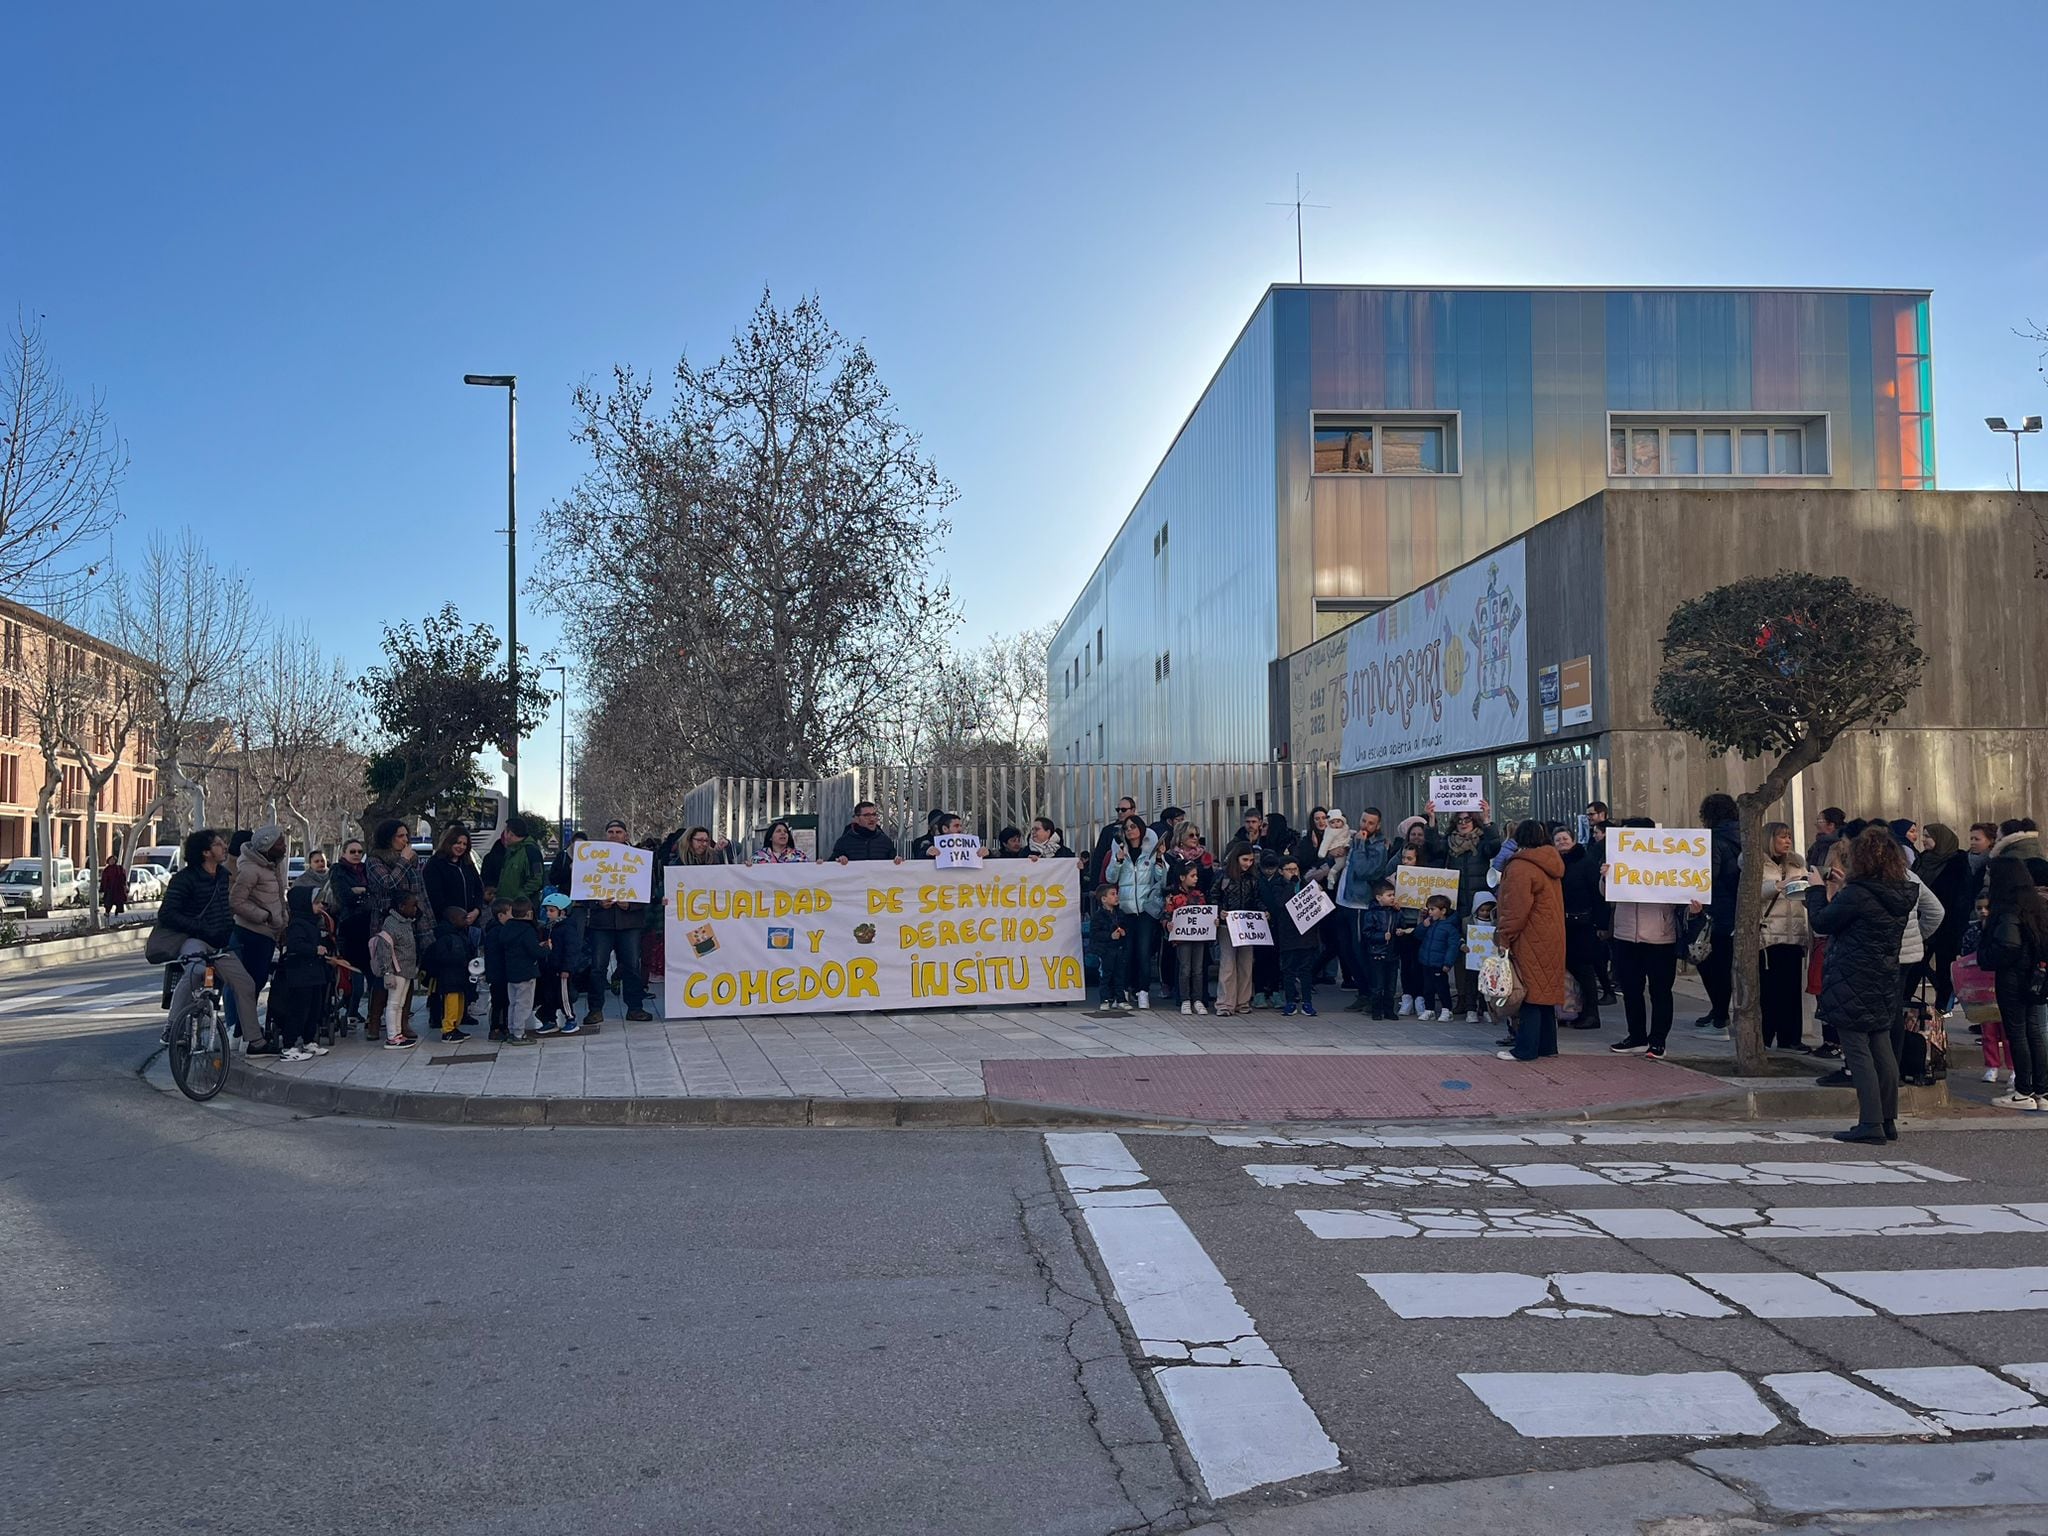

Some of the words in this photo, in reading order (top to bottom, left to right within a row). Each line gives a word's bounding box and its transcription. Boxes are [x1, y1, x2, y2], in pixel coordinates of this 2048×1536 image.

[1328, 672, 1349, 731] 75
[939, 837, 977, 848] COCINA
[1618, 831, 1706, 857] FALSAS
[577, 842, 610, 861] CON
[623, 851, 645, 865] LA
[950, 850, 970, 862] ¡YA!
[596, 860, 638, 874] SALUD
[608, 873, 627, 885] SE
[1613, 862, 1711, 893] PROMESAS
[586, 885, 637, 900] JUEGA
[867, 886, 904, 914] DE
[1176, 906, 1213, 917] ¡COMEDOR
[1187, 917, 1197, 925] DE
[1246, 922, 1255, 930] DE
[806, 929, 825, 953] Y
[900, 915, 1056, 949] DERECHOS
[1175, 927, 1209, 936] CALIDAD!
[683, 957, 880, 1008] COMEDOR
[1040, 956, 1083, 990] YA
